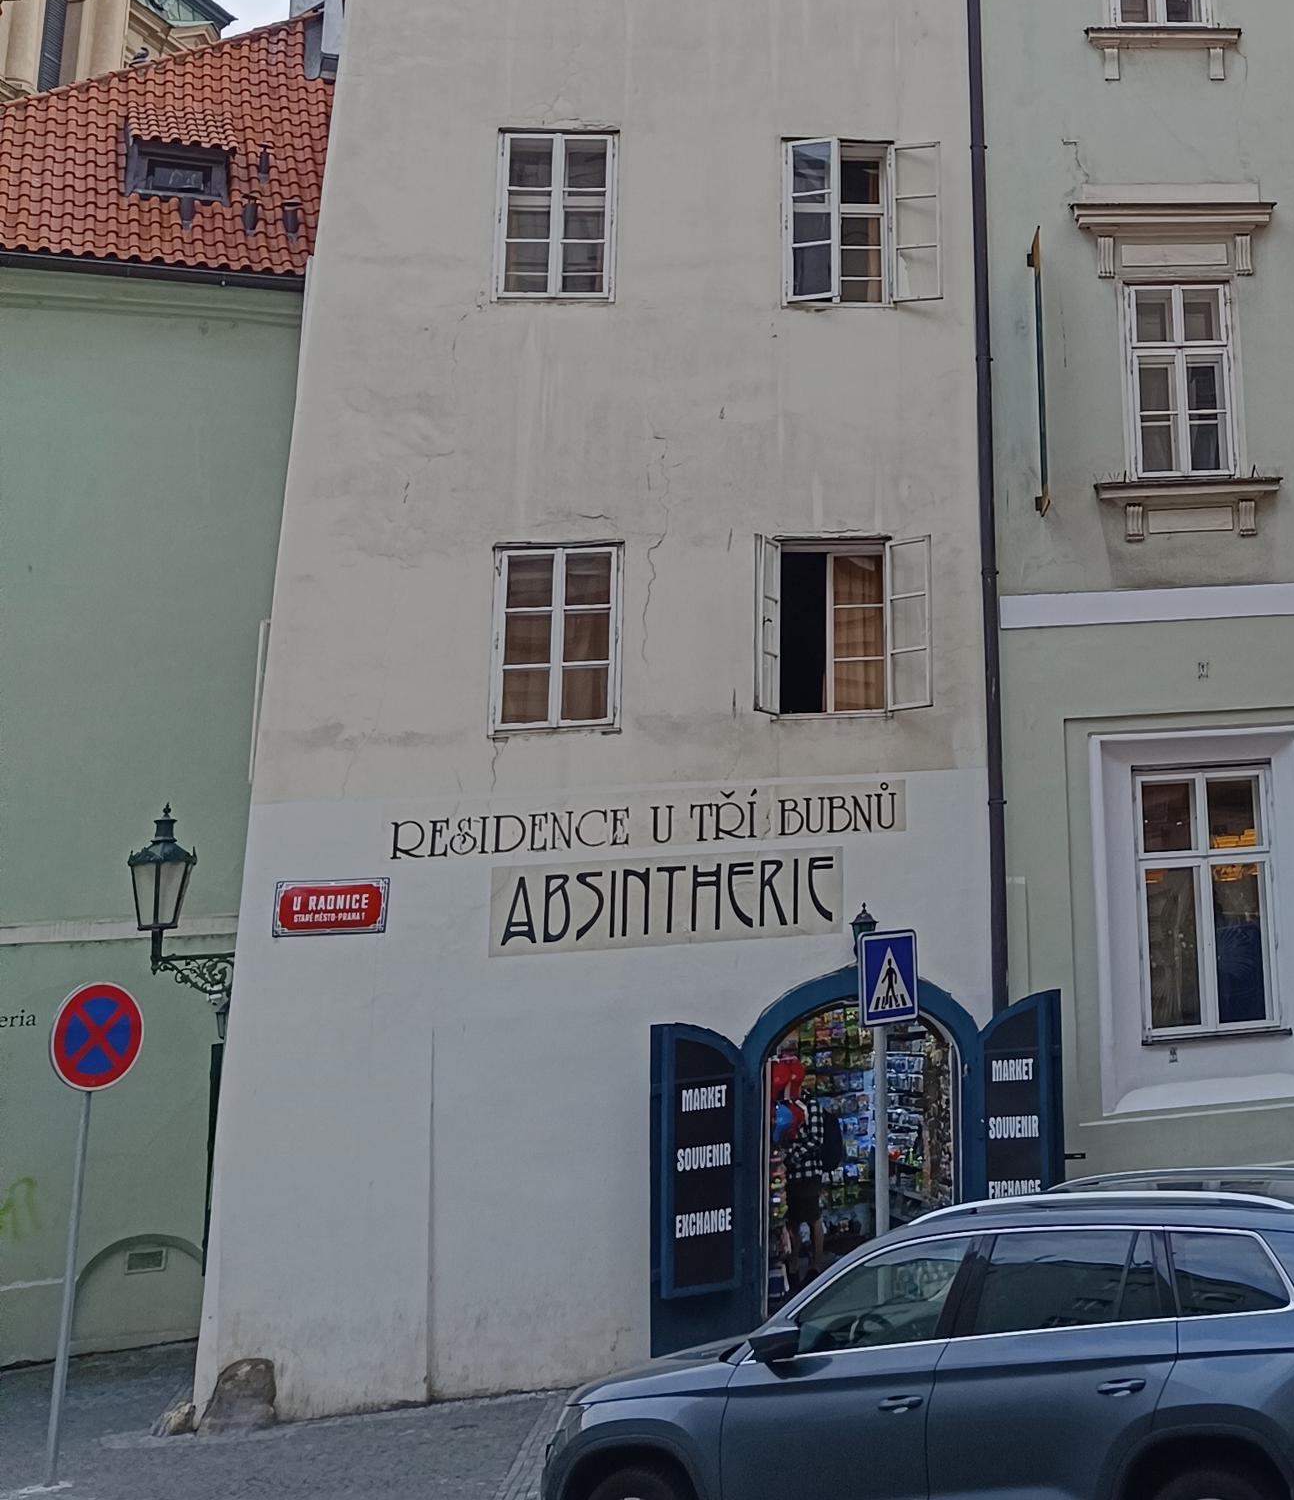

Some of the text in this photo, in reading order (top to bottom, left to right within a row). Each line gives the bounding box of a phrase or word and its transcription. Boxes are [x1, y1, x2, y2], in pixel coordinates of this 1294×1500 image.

[390, 782, 897, 860] RESIDENCE U TŘÍ BUBNŮ
[292, 893, 370, 911] U RADNICE
[500, 855, 834, 947] ABSINTHERIE
[991, 1058, 1034, 1082] MARKET
[681, 1084, 727, 1112] MARKET
[988, 1115, 1039, 1140] SOUVENIR
[676, 1142, 732, 1172] SOUVENIR
[675, 1207, 733, 1239] EXCHANGE
